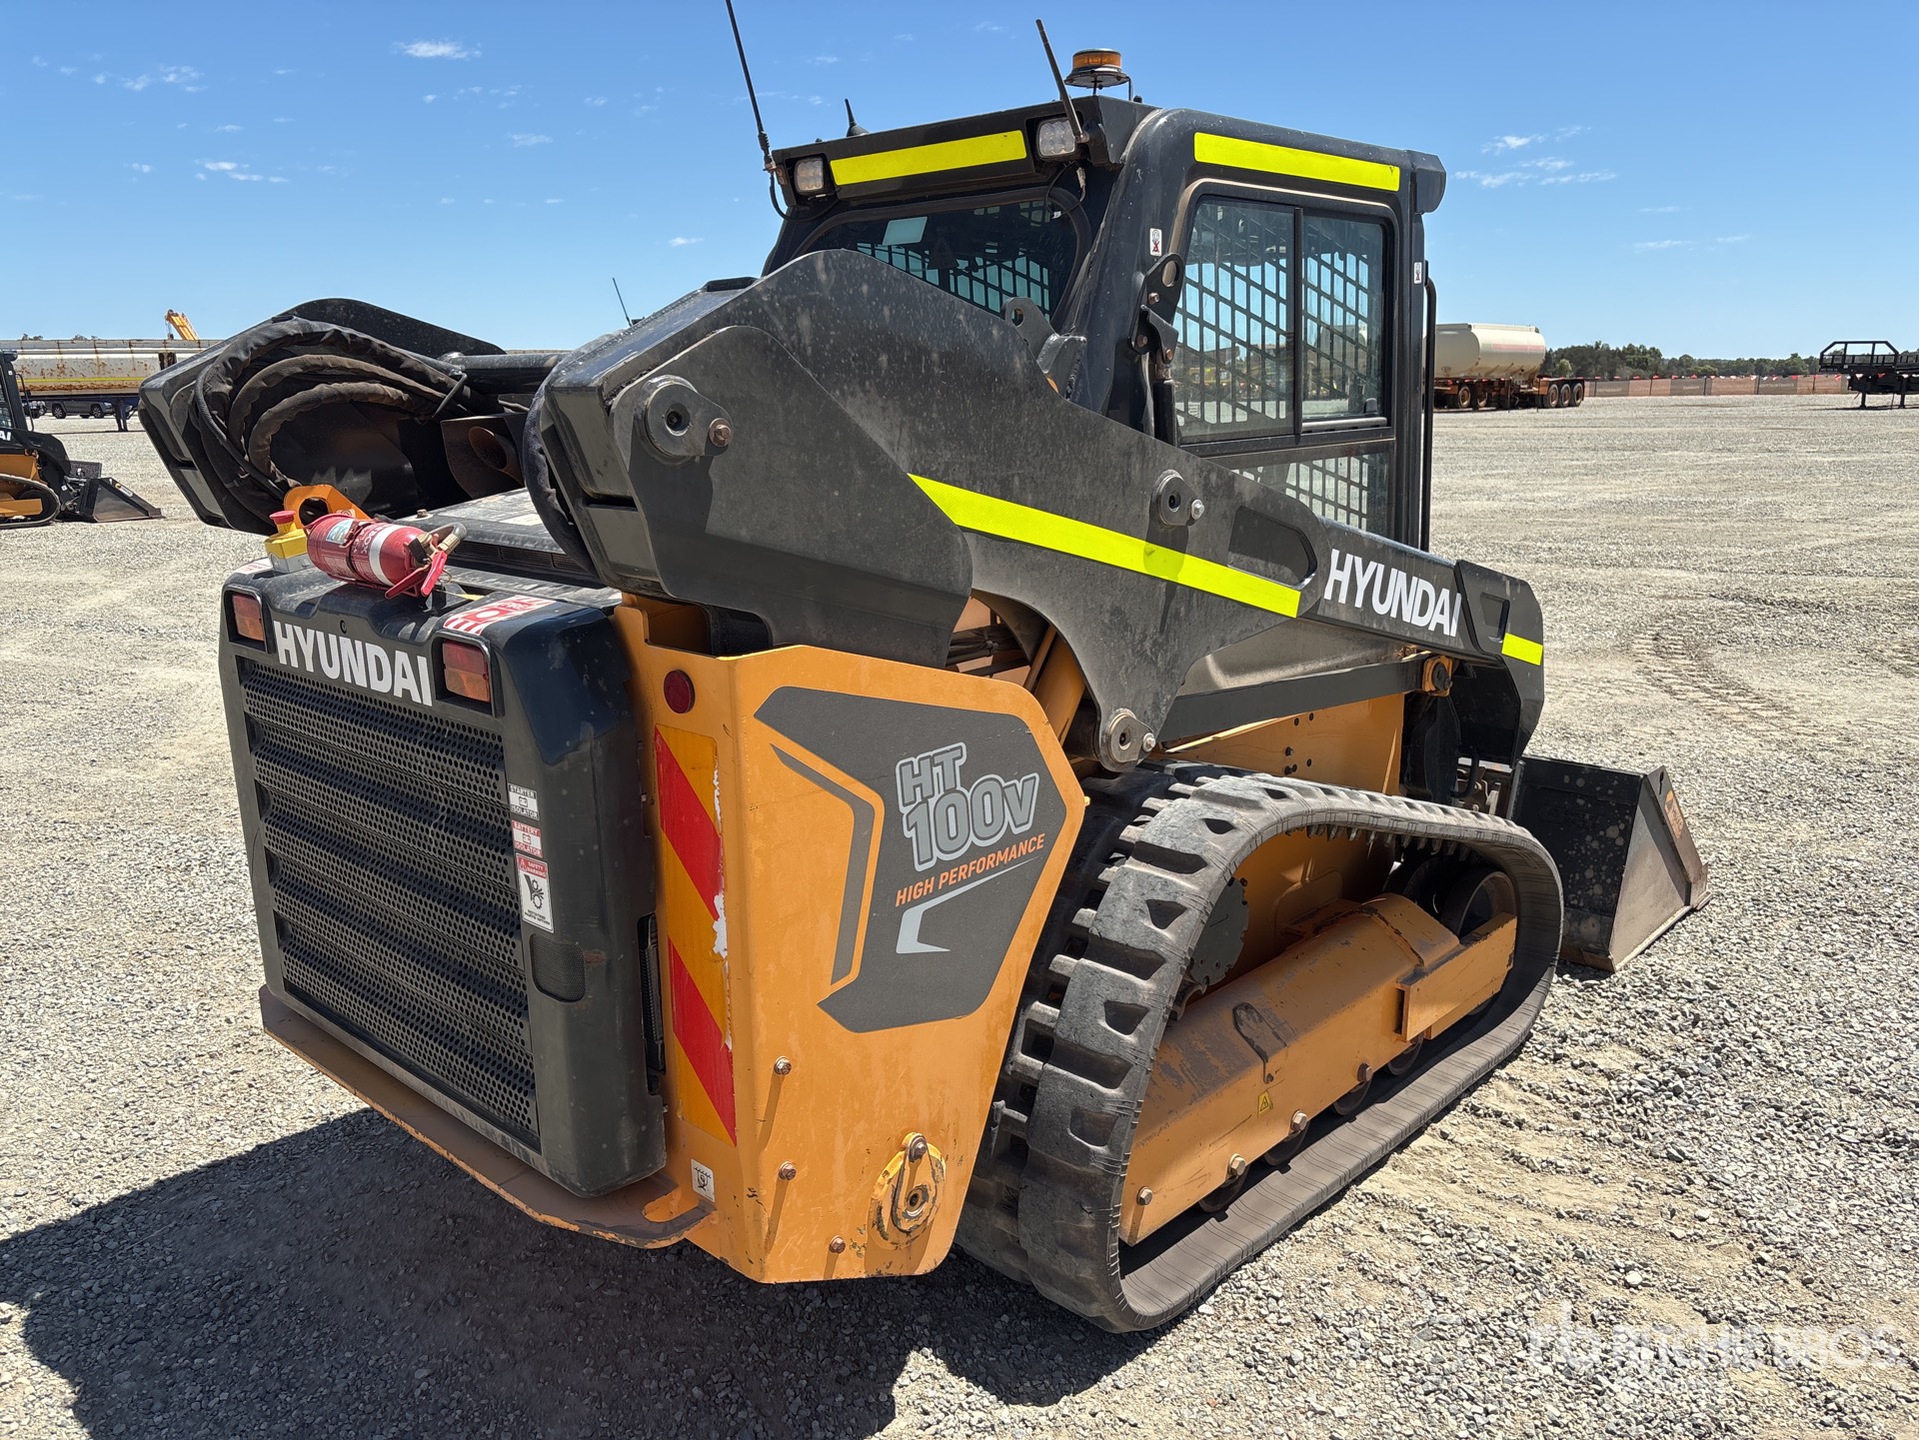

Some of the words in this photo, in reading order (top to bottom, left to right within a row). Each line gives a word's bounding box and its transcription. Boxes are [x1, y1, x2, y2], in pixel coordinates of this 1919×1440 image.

[1323, 548, 1462, 637] HYUNDAI
[273, 621, 434, 707] HYUNDAI
[511, 784, 535, 798] STARTER
[511, 805, 538, 819] ISOLATOR
[896, 742, 967, 814] HT
[895, 877, 934, 907] HIGH
[938, 833, 1046, 890] PERFORMANCE
